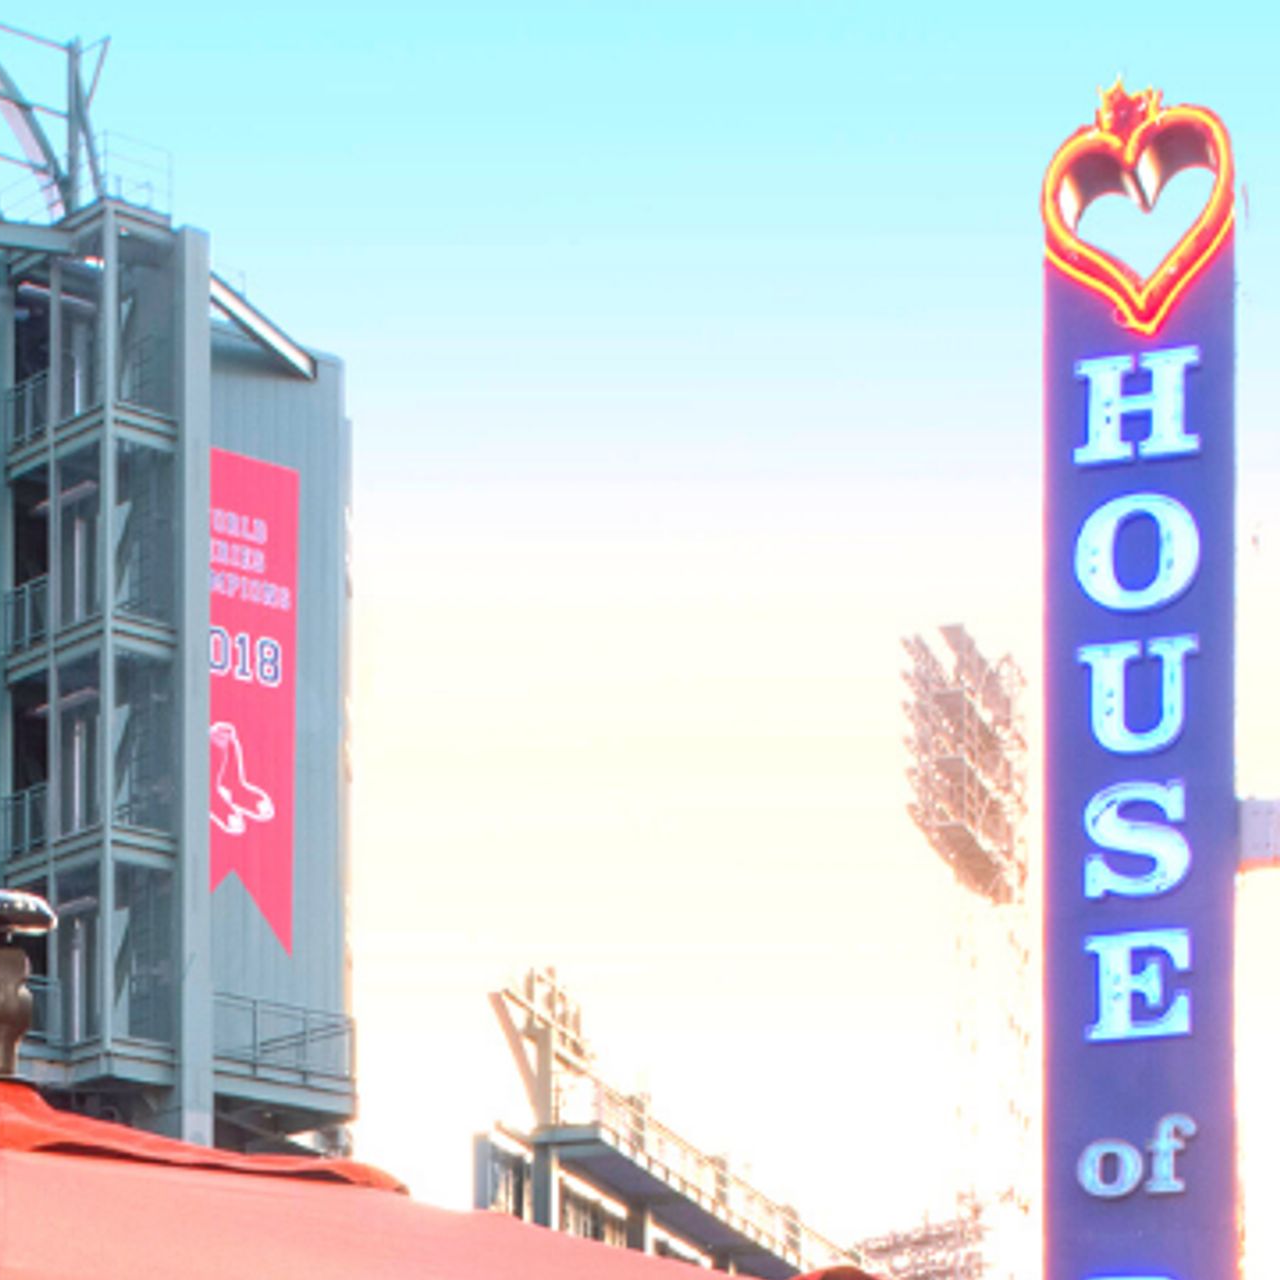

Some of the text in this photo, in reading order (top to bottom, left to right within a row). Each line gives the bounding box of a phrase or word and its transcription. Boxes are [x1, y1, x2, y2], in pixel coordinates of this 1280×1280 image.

[210, 508, 268, 545] ORLD
[210, 625, 282, 688] 018
[1073, 344, 1201, 1044] HOUSE
[1076, 1112, 1197, 1199] of
